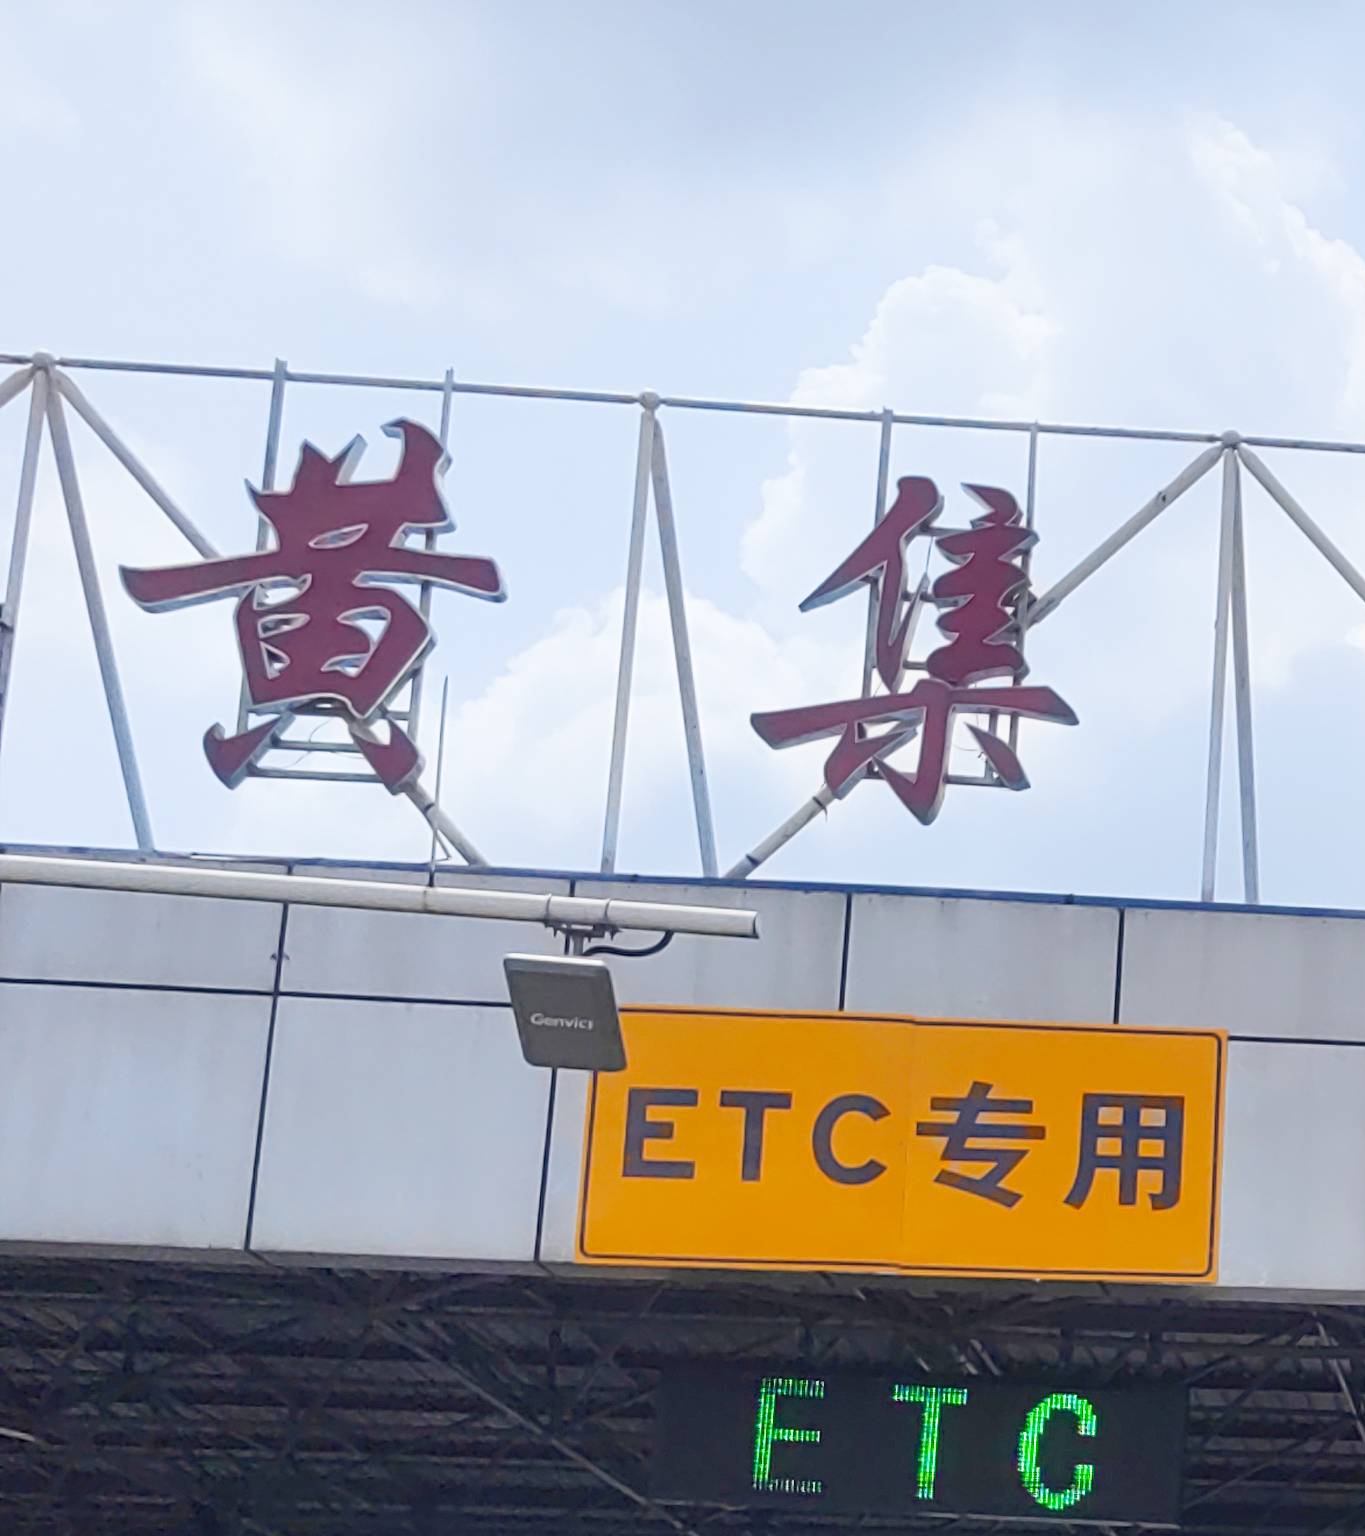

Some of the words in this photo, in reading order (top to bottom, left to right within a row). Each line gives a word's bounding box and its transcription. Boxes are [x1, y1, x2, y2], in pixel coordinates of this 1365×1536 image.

[119, 417, 1080, 825] 黄集
[620, 1080, 1186, 1211] ETC专用
[752, 1376, 1097, 1511] ETC
